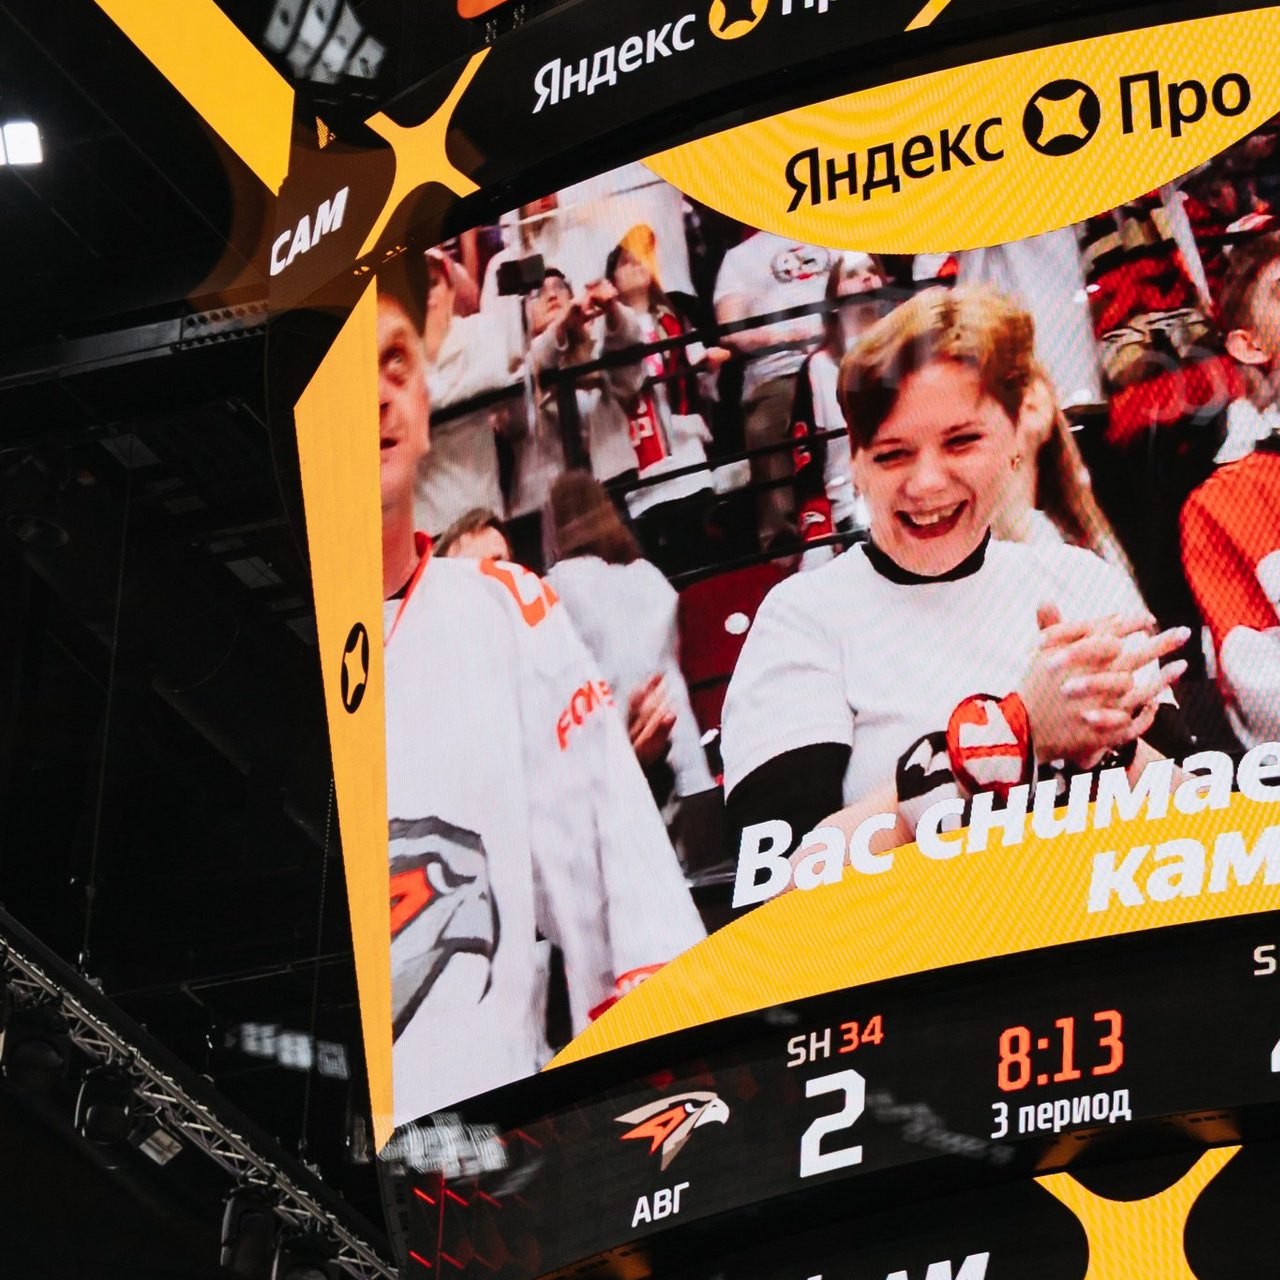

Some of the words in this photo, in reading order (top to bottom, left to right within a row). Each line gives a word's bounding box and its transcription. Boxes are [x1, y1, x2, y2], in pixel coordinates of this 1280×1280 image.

[532, 13, 696, 114] Яндекс
[785, 117, 1004, 213] Яндекс
[1119, 69, 1251, 138] Про
[731, 811, 897, 909] Вас
[786, 1027, 831, 1068] SH
[838, 1014, 885, 1054] 34
[997, 1009, 1125, 1093] 8:13
[799, 1068, 866, 1179] 2
[990, 1101, 1009, 1139] 3
[1018, 1088, 1132, 1134] период
[631, 1181, 690, 1228] АВГ
